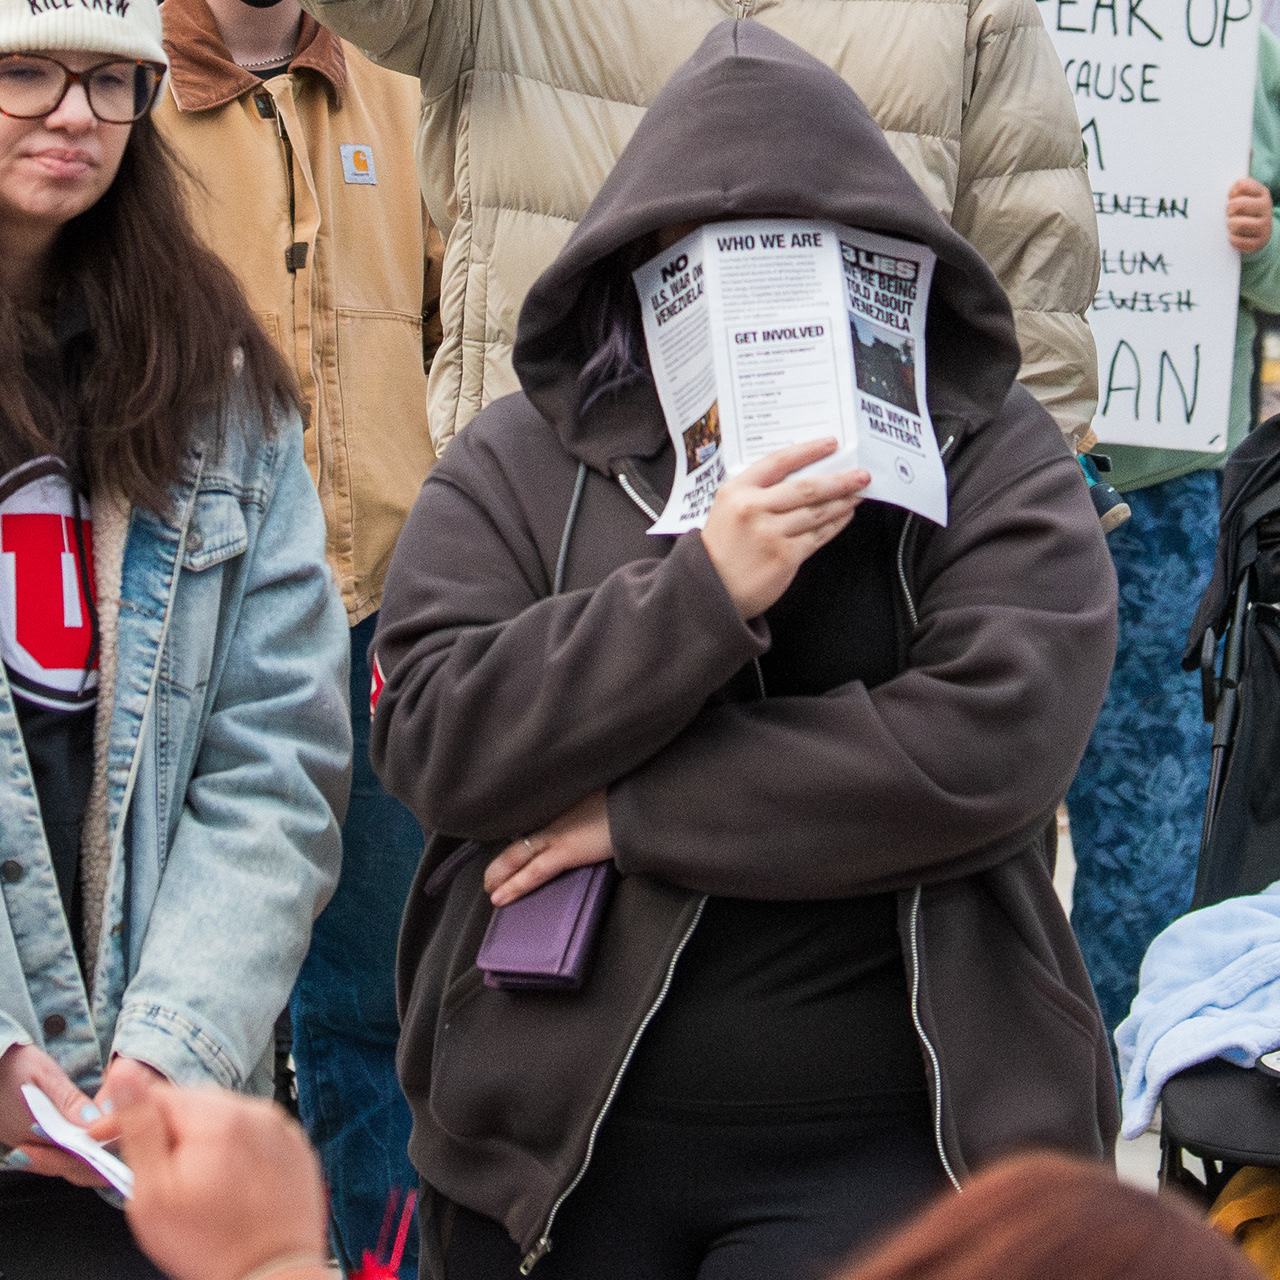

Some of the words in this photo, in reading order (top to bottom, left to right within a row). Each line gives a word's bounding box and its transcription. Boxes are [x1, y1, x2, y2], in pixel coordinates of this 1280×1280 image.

[717, 235, 755, 252] WHO
[760, 233, 786, 248] WE
[791, 232, 823, 248] ARE
[661, 253, 689, 284] NO
[858, 250, 917, 281] LIES
[878, 276, 917, 300] BEING
[874, 290, 914, 316] ABOUT
[735, 331, 757, 344] GET
[762, 325, 824, 342] INVOLVED
[869, 417, 921, 448] MATTERS
